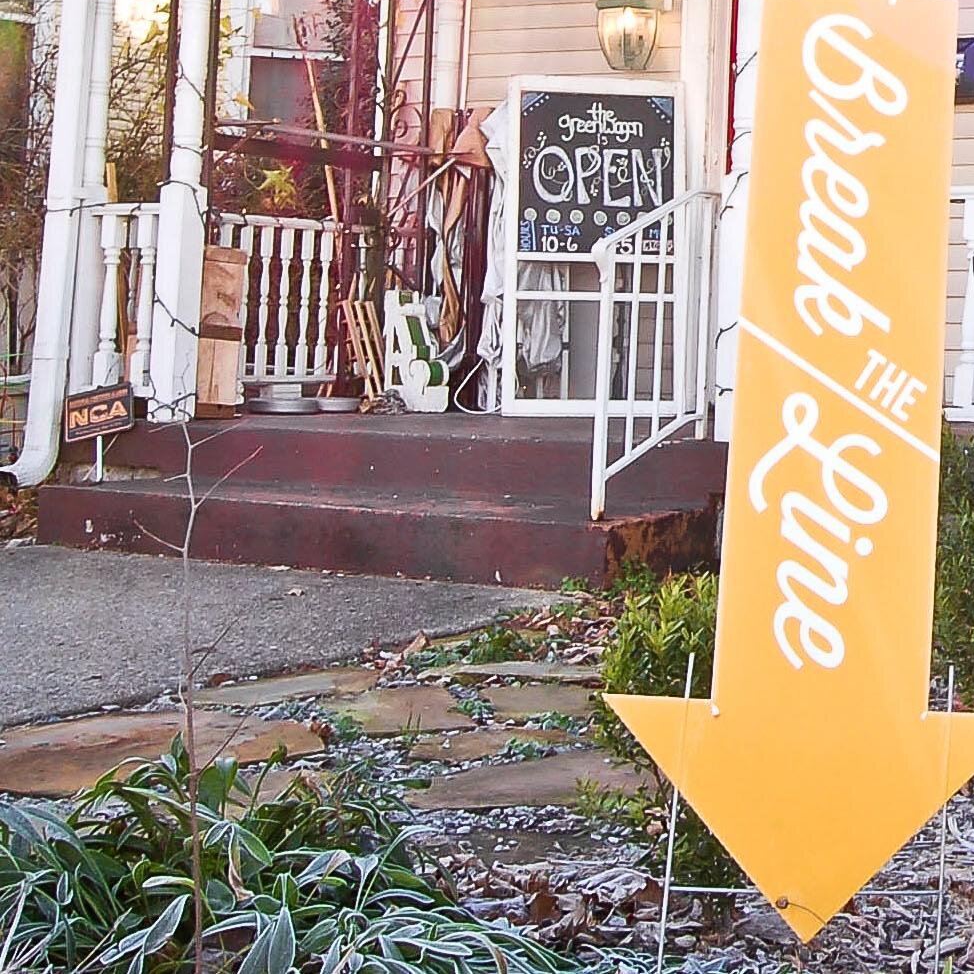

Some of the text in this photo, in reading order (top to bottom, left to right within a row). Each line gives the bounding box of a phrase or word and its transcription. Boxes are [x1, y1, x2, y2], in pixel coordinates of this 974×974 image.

[533, 145, 663, 208] OPEN
[541, 235, 578, 252] 10-6
[748, 12, 928, 671] Break THE Line
[69, 400, 128, 429] NCA
